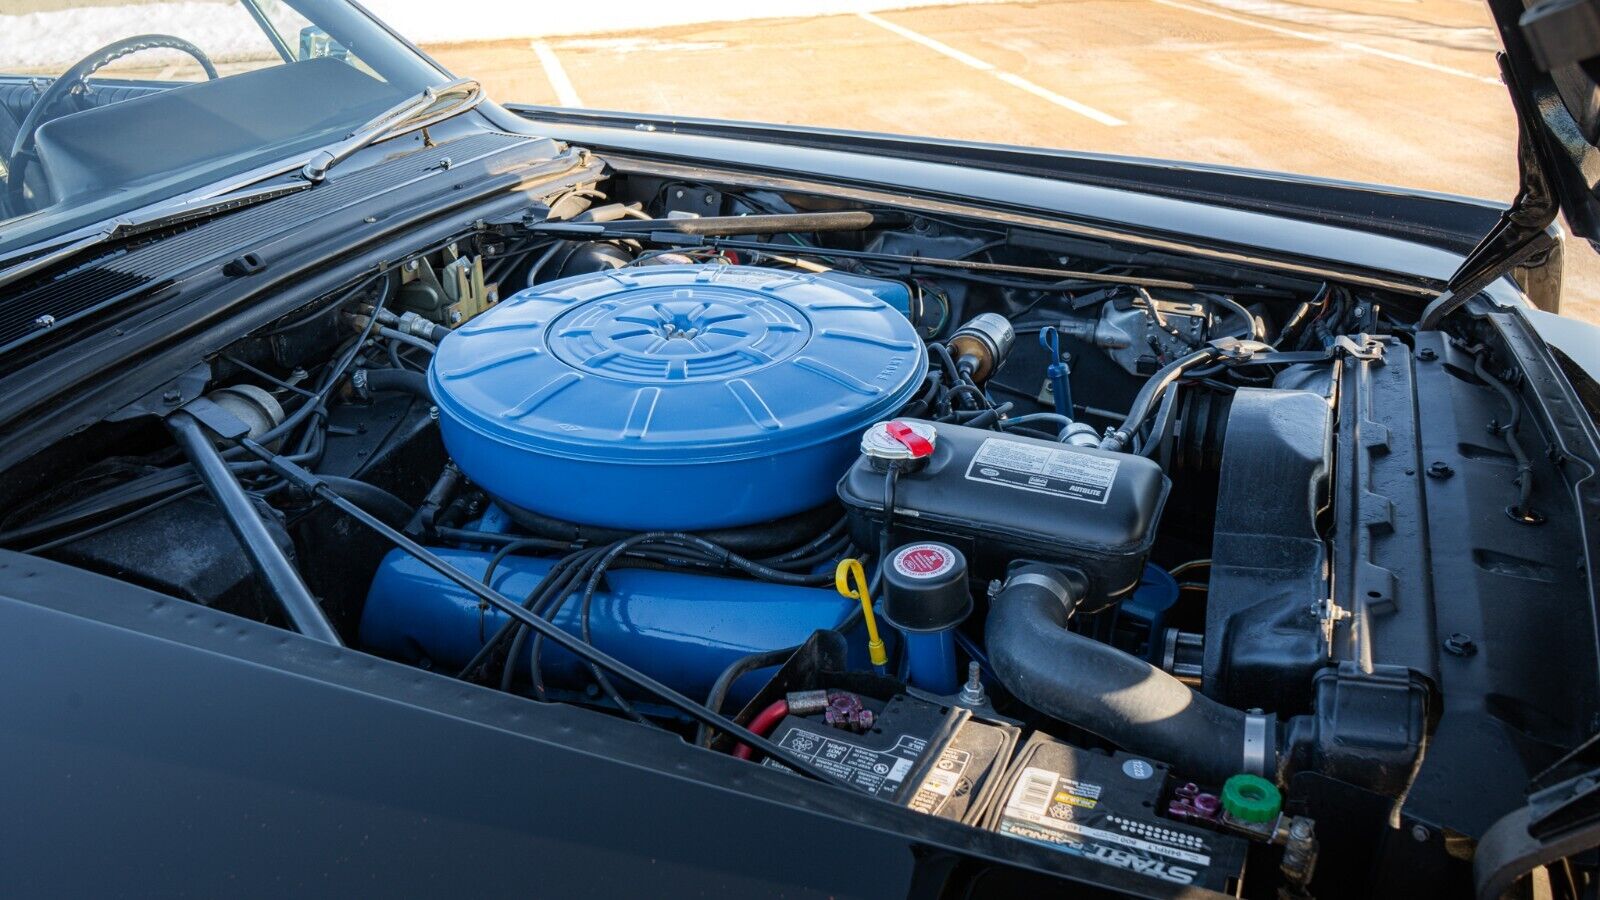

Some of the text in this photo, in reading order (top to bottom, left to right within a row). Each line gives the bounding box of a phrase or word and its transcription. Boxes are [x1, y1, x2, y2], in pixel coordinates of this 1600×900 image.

[1069, 485, 1101, 496] AUTOLITE
[1008, 825, 1084, 849] PLATINUM
[1084, 844, 1198, 885] START
